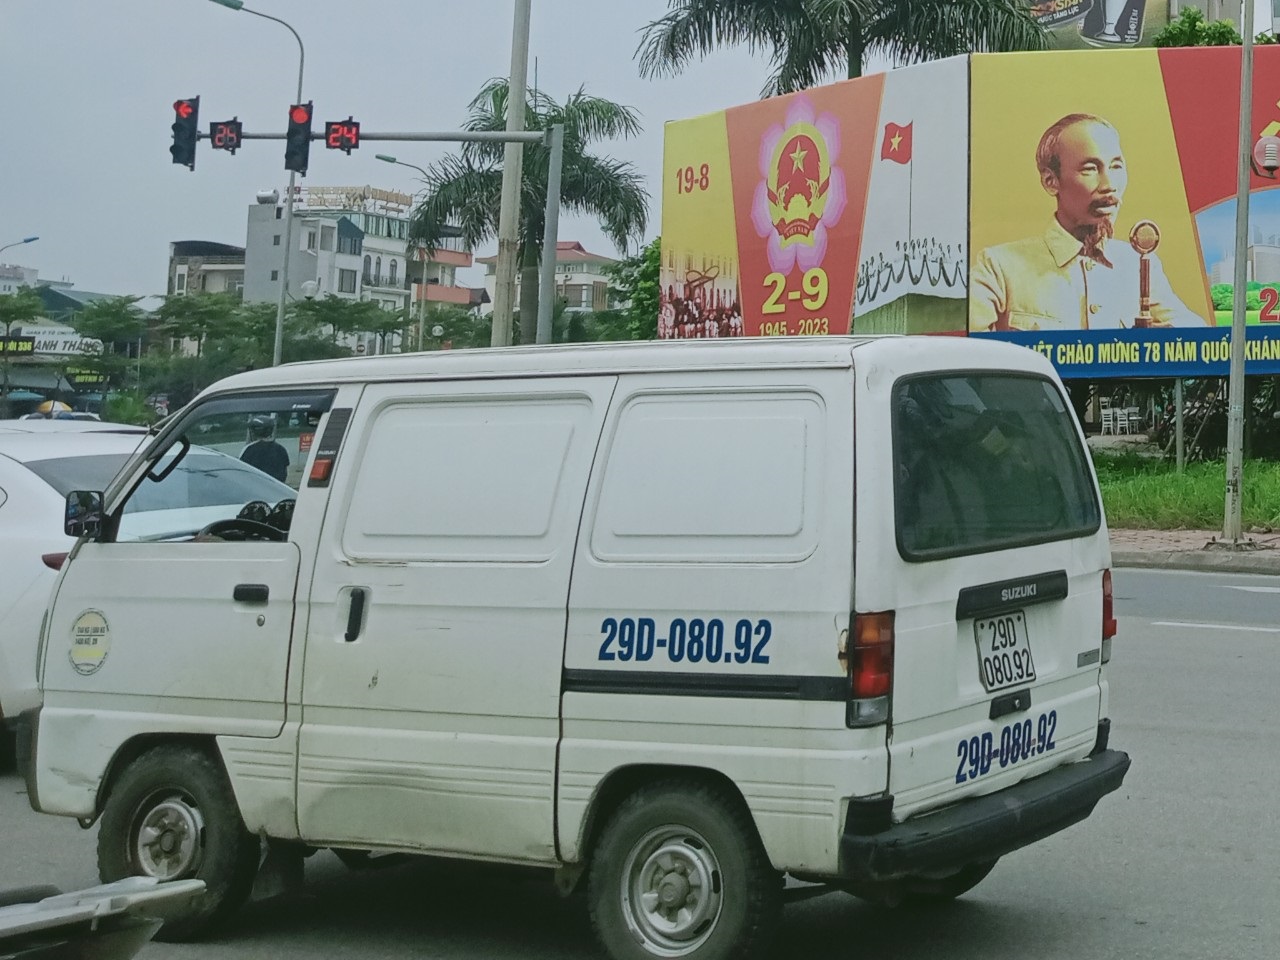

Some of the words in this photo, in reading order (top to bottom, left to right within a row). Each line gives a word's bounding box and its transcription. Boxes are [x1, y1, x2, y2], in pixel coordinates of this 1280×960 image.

[328, 124, 357, 147] 24
[675, 163, 710, 195] 19-8
[760, 266, 830, 315] 2-9
[759, 321, 788, 336] 1945
[798, 317, 830, 336] 2023
[1056, 339, 1094, 365] CHÀO
[1097, 337, 1140, 364] MỪNG
[1143, 342, 1161, 363] 78
[1164, 336, 1197, 363] NĂM
[1201, 332, 1231, 365] QUỐ
[1001, 583, 1037, 602] SUZUKI
[598, 617, 772, 665] 29D-080.92
[988, 617, 1017, 652] 29D
[983, 647, 1035, 688] 080.92
[955, 709, 1057, 784] 29D-080.92
